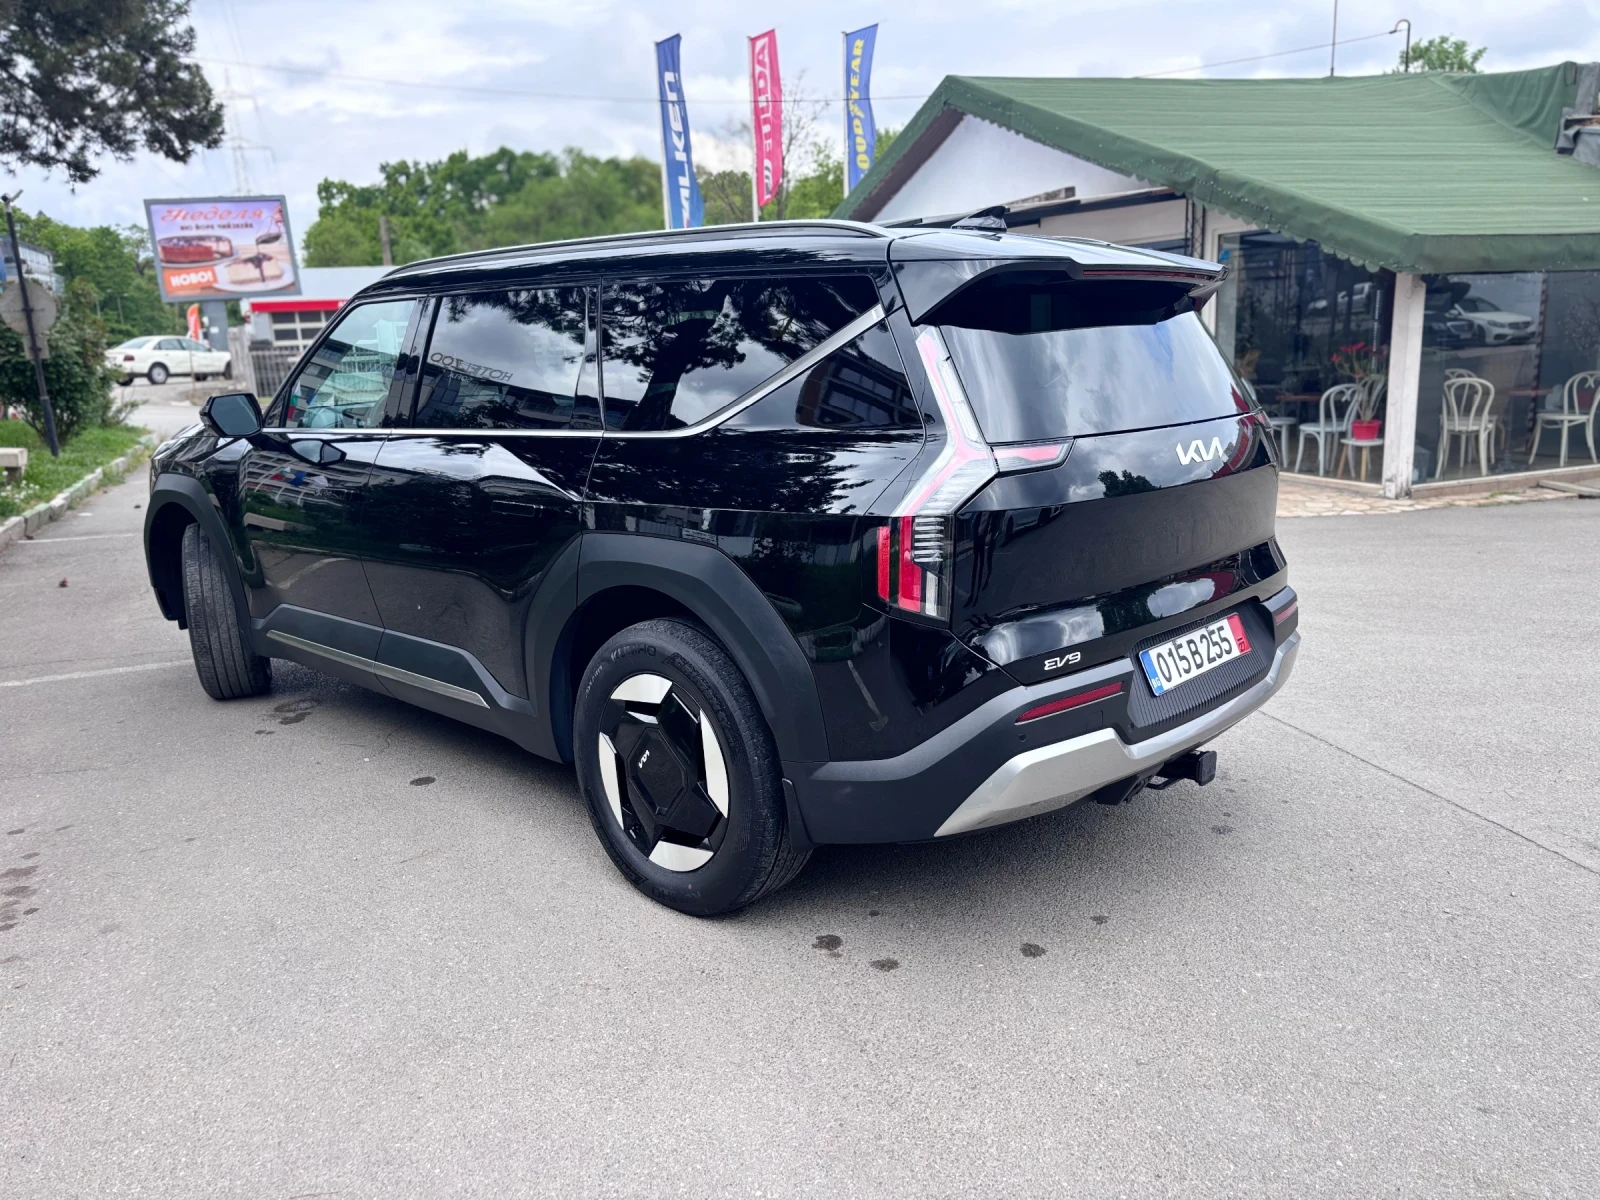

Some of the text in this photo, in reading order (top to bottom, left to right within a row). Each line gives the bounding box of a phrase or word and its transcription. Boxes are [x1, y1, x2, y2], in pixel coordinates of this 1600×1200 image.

[755, 37, 772, 152] FULDA
[849, 39, 870, 177] OODYEAR
[170, 270, 214, 287] НОВО!
[1175, 436, 1224, 466] KIA
[1044, 651, 1081, 671] EV9
[1156, 625, 1233, 683] 015B255
[1151, 677, 1162, 688] BG
